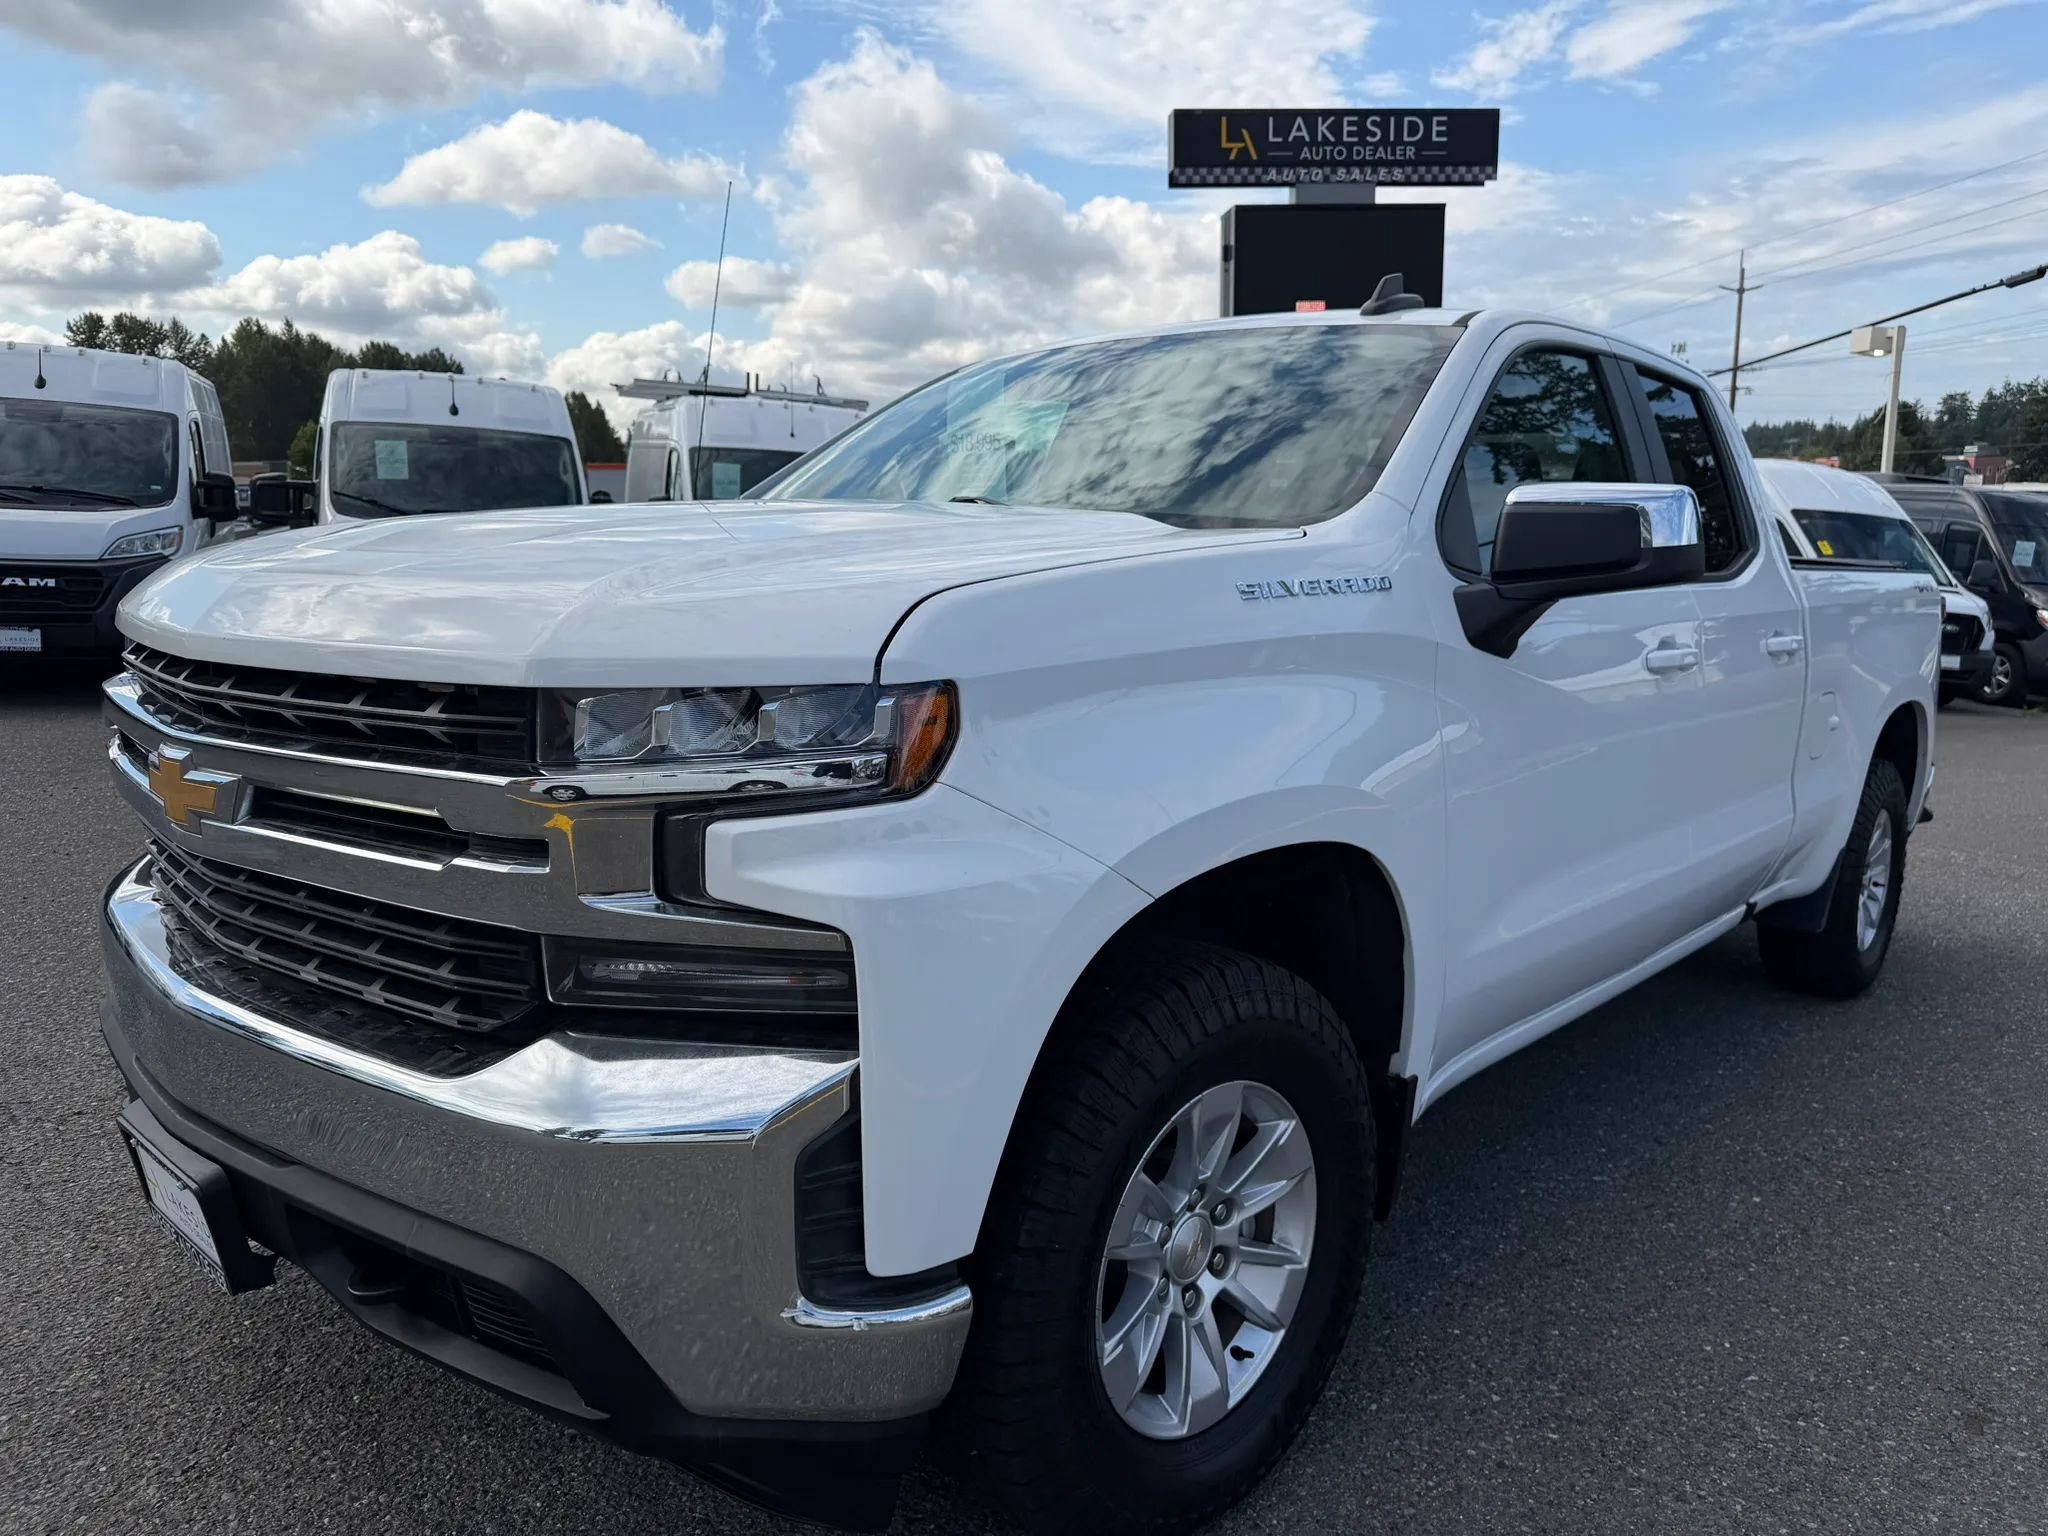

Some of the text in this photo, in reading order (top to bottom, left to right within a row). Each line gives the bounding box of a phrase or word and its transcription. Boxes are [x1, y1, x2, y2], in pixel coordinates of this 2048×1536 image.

[1268, 116, 1448, 142] LAKESIDE
[1300, 146, 1415, 160] AUTO DEALER
[1266, 167, 1403, 181] AUTO SALES
[0, 577, 55, 587] AM
[1236, 575, 1393, 600] SILVERADO
